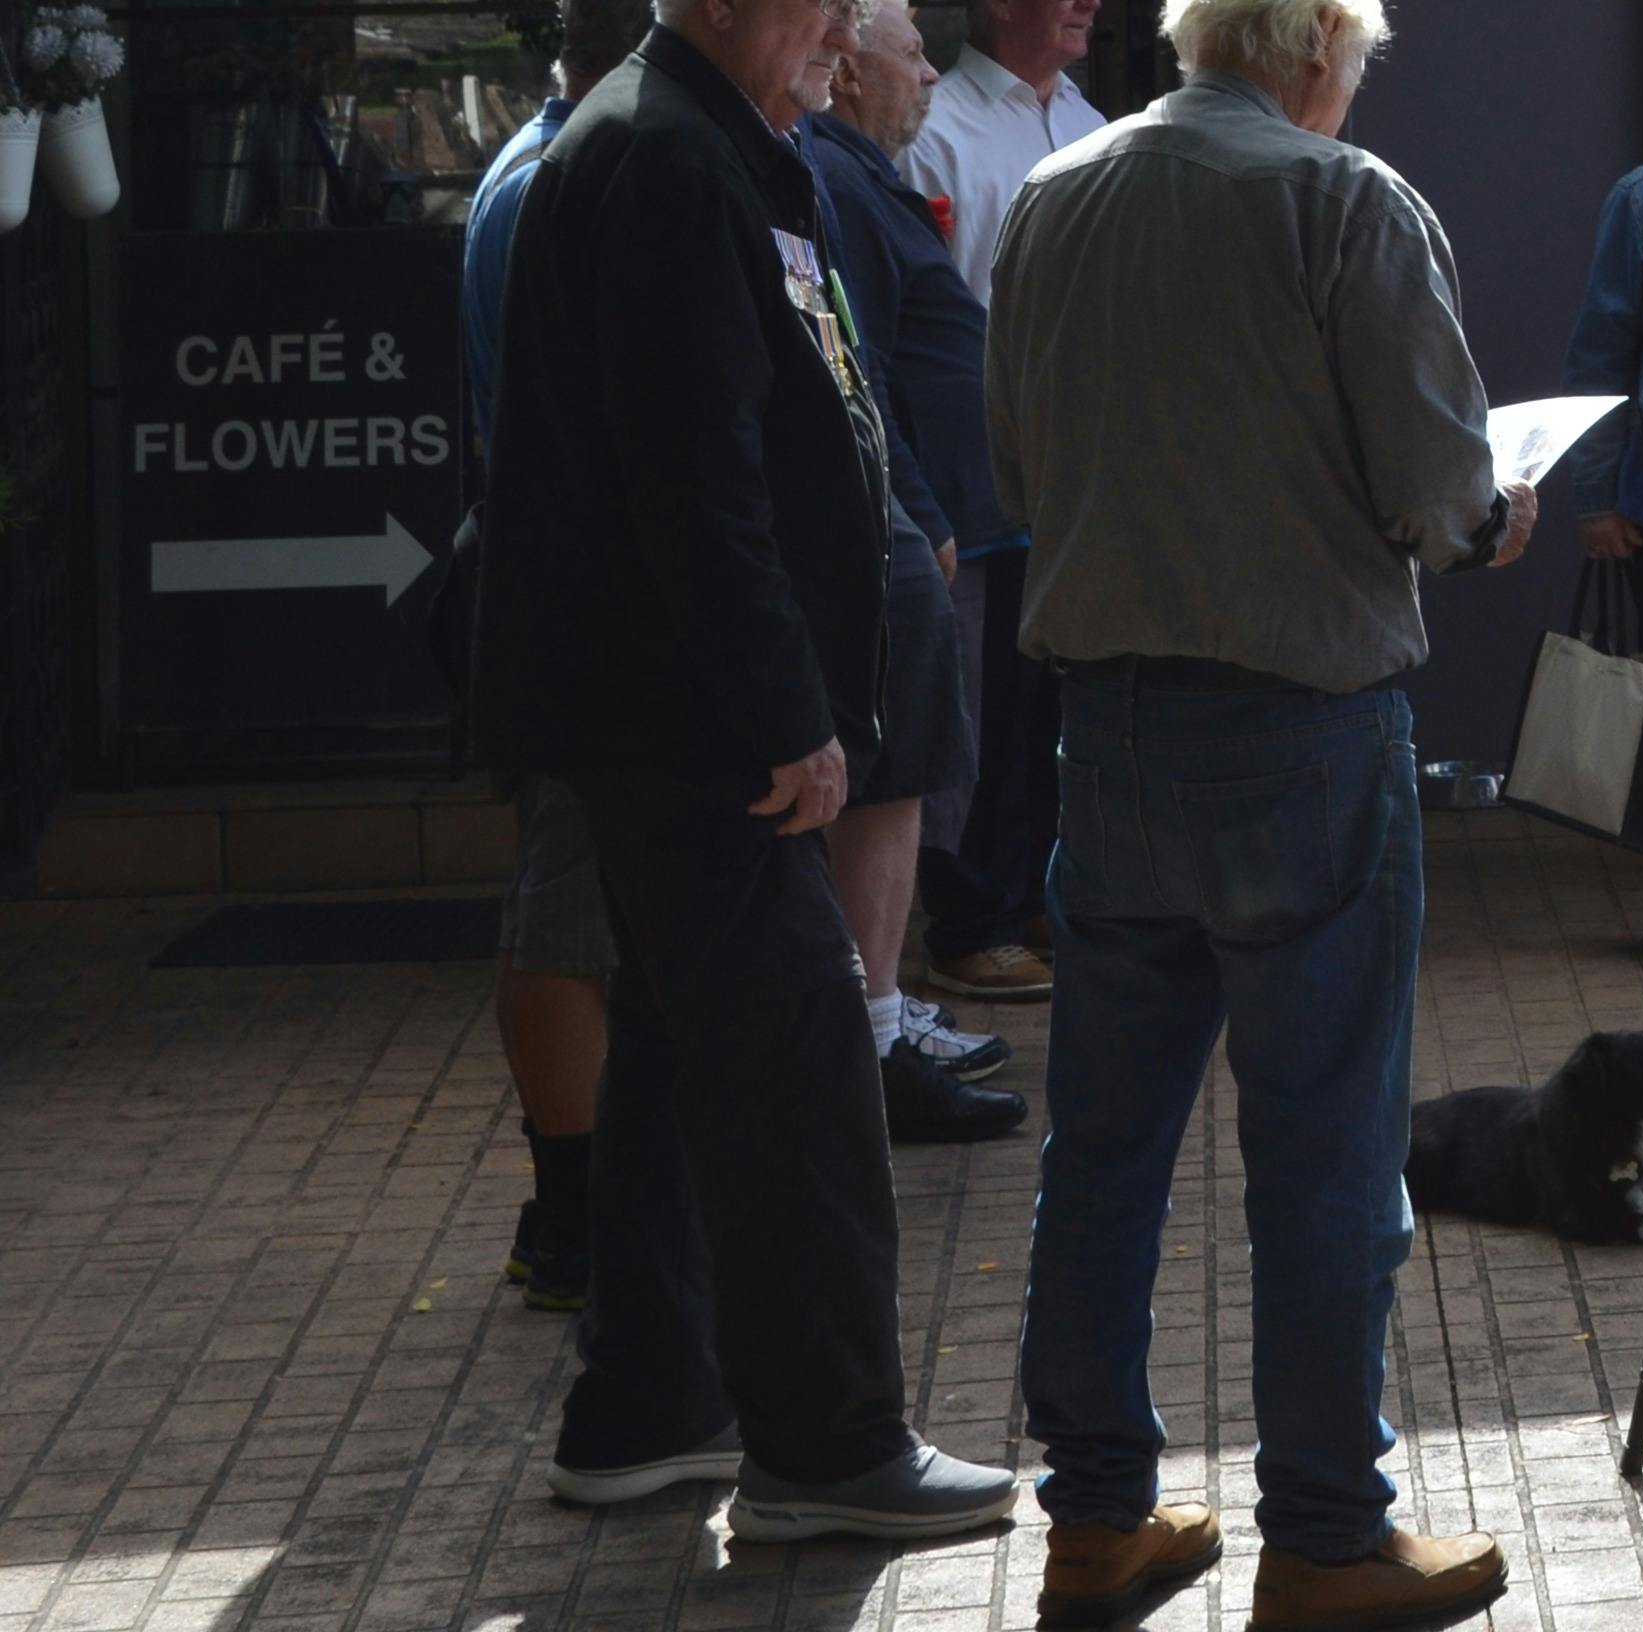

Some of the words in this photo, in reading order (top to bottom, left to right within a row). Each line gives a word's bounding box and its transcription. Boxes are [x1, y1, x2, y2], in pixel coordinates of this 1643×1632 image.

[175, 319, 346, 386] CAFÉ
[365, 331, 407, 381] &
[134, 414, 450, 473] FLOWERS
